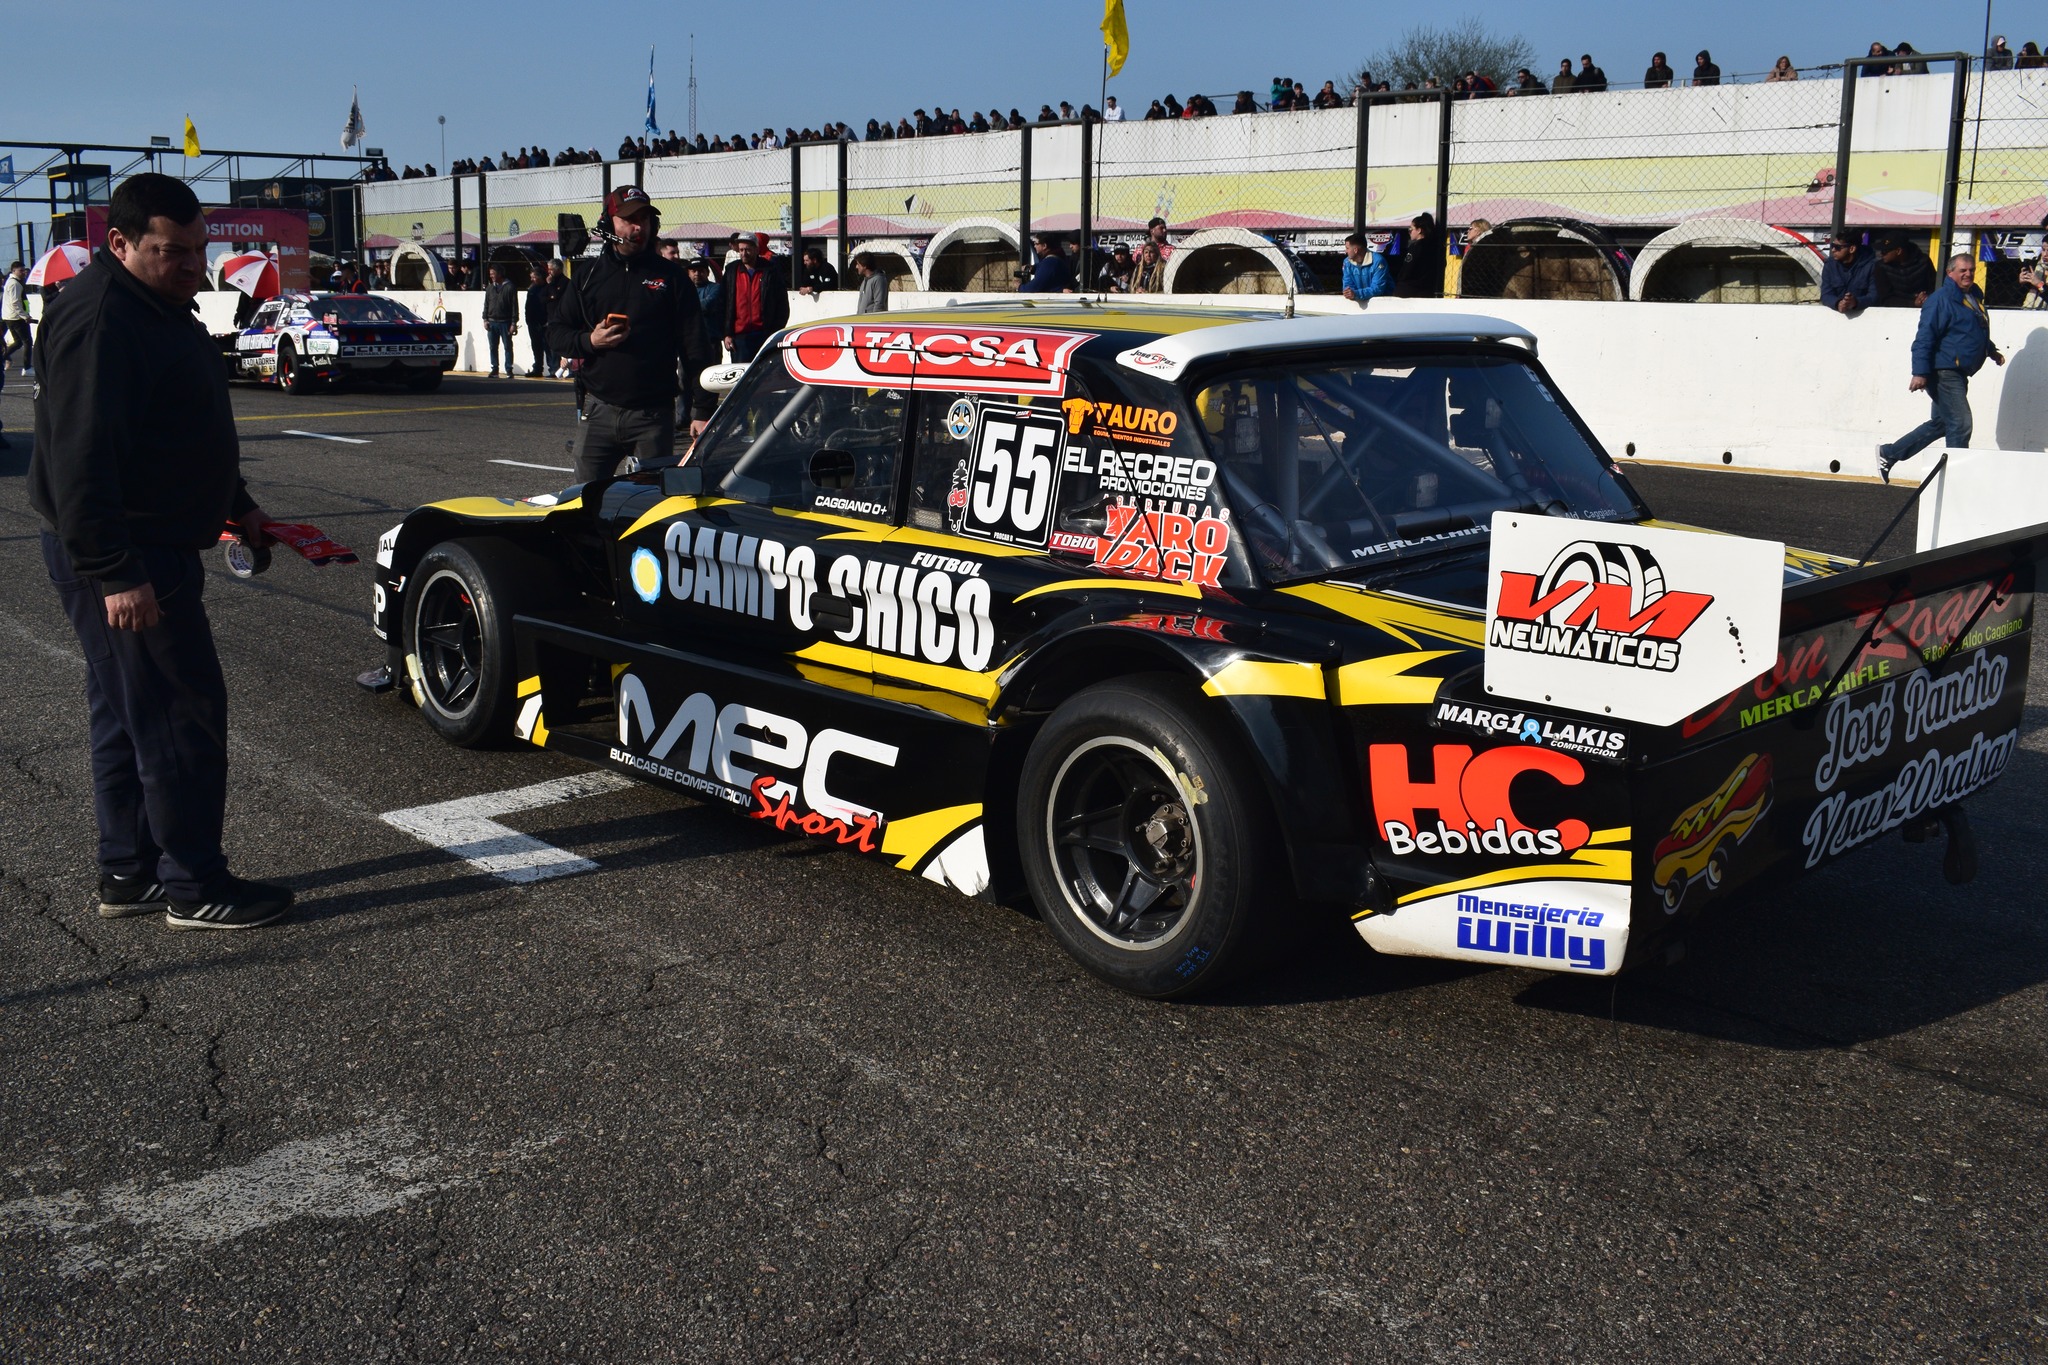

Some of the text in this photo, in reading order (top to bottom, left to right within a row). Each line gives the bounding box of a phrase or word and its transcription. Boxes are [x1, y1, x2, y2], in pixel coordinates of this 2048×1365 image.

[1996, 233, 2027, 247] 15
[356, 344, 449, 353] CITERGAZ
[864, 331, 1042, 369] TACSA
[1096, 402, 1178, 435] TAURO
[1133, 436, 1171, 448] INDUSTRIALES
[973, 420, 1056, 533] 55
[1063, 446, 1218, 488] EL RECREO
[814, 494, 872, 514] CAGGIANO
[1099, 475, 1207, 502] PROMOCIONES
[1583, 508, 1618, 521] Caggiano
[911, 551, 984, 578] FUTBOL
[664, 520, 995, 673] CAMPO CHICO
[1496, 570, 1716, 640] VM
[1491, 619, 1680, 672] NEUMATICOS
[1961, 633, 1983, 651] Aldo
[1985, 617, 2024, 642] Caggiano
[1815, 647, 2008, 793] José Pancho
[609, 747, 752, 808] BUTACAS DE COMPETICION
[750, 775, 877, 853] Sport
[1369, 743, 1590, 851] HC
[1383, 818, 1563, 856] Bebidas
[1456, 893, 1606, 928] Mensajeria
